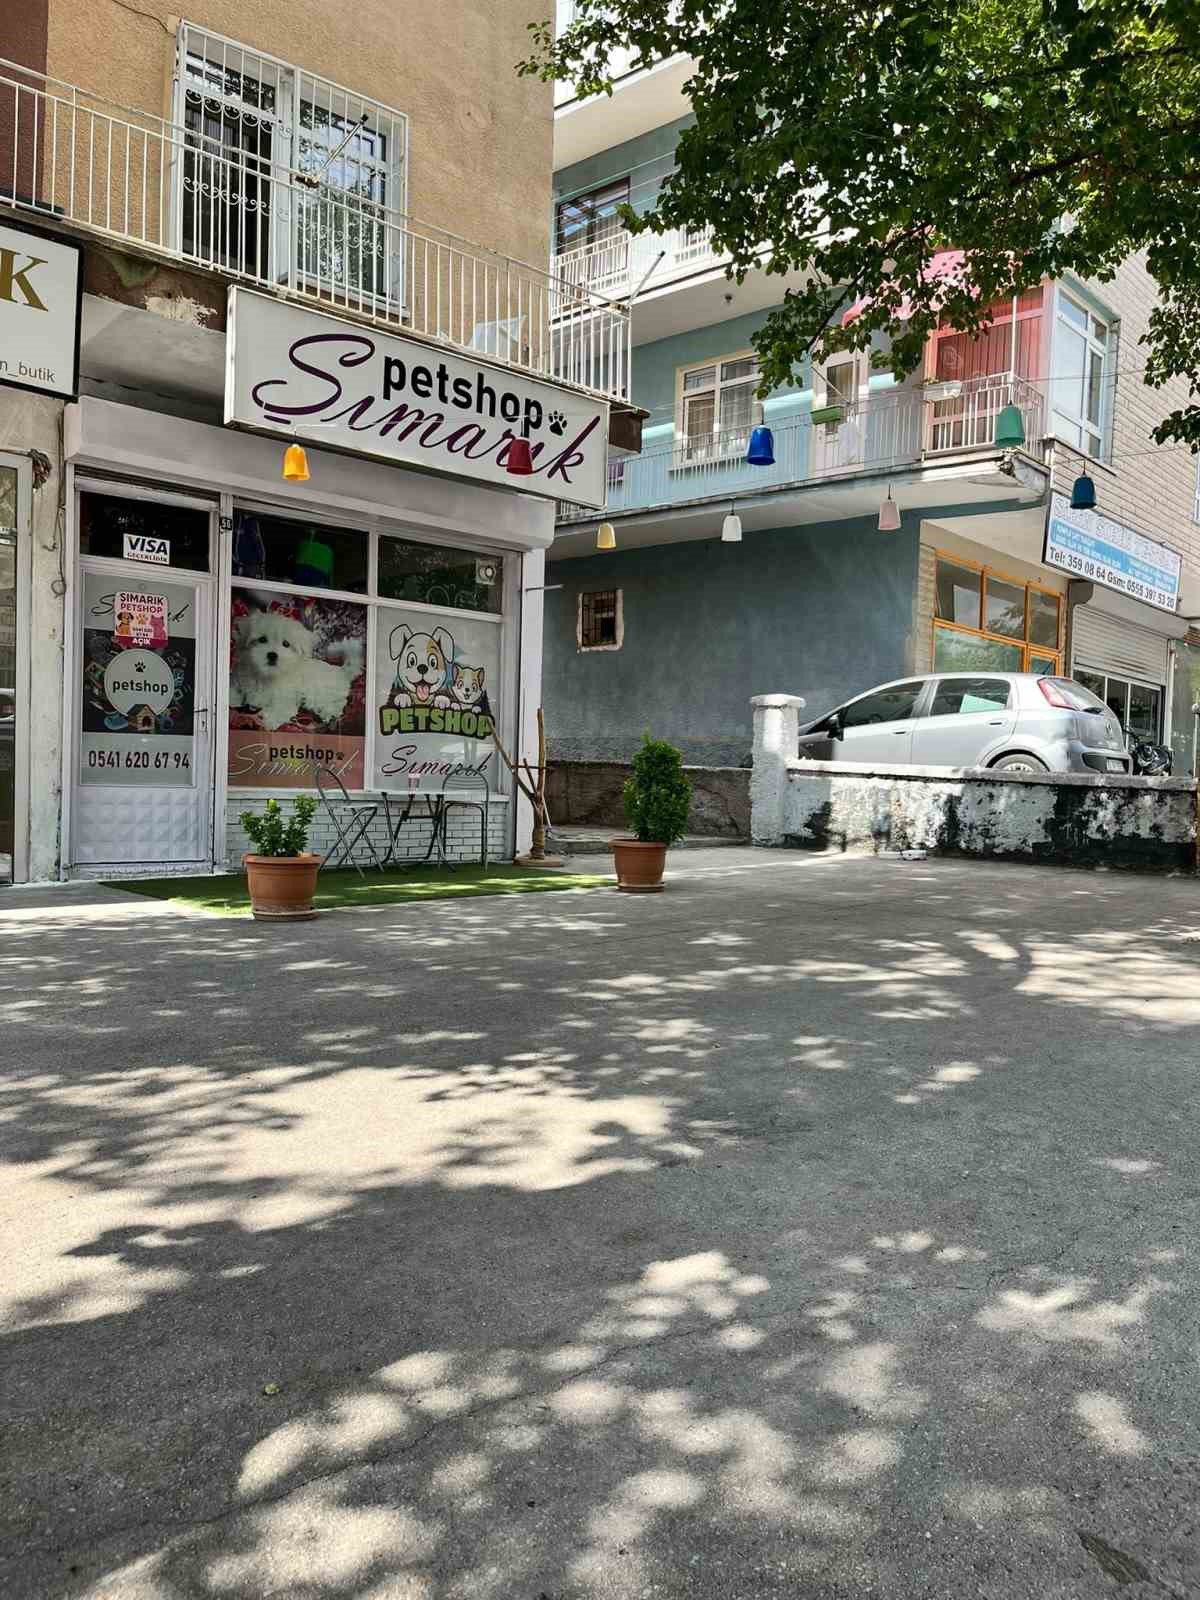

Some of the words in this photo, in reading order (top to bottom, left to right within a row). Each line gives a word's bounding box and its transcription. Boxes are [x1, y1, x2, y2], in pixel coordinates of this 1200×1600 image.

[383, 355, 543, 440] petshop
[128, 536, 168, 555] VISA
[1050, 547, 1065, 564] Tel:
[1068, 554, 1083, 571] 359
[1085, 563, 1095, 575] 08
[121, 603, 163, 613] PETSHOP
[112, 679, 169, 696] petshop
[381, 705, 493, 738] PETSHOP
[88, 751, 121, 768] 0541
[125, 751, 150, 769] 620
[154, 752, 169, 769] 67
[174, 753, 190, 769] 94
[269, 745, 334, 765] petshop
